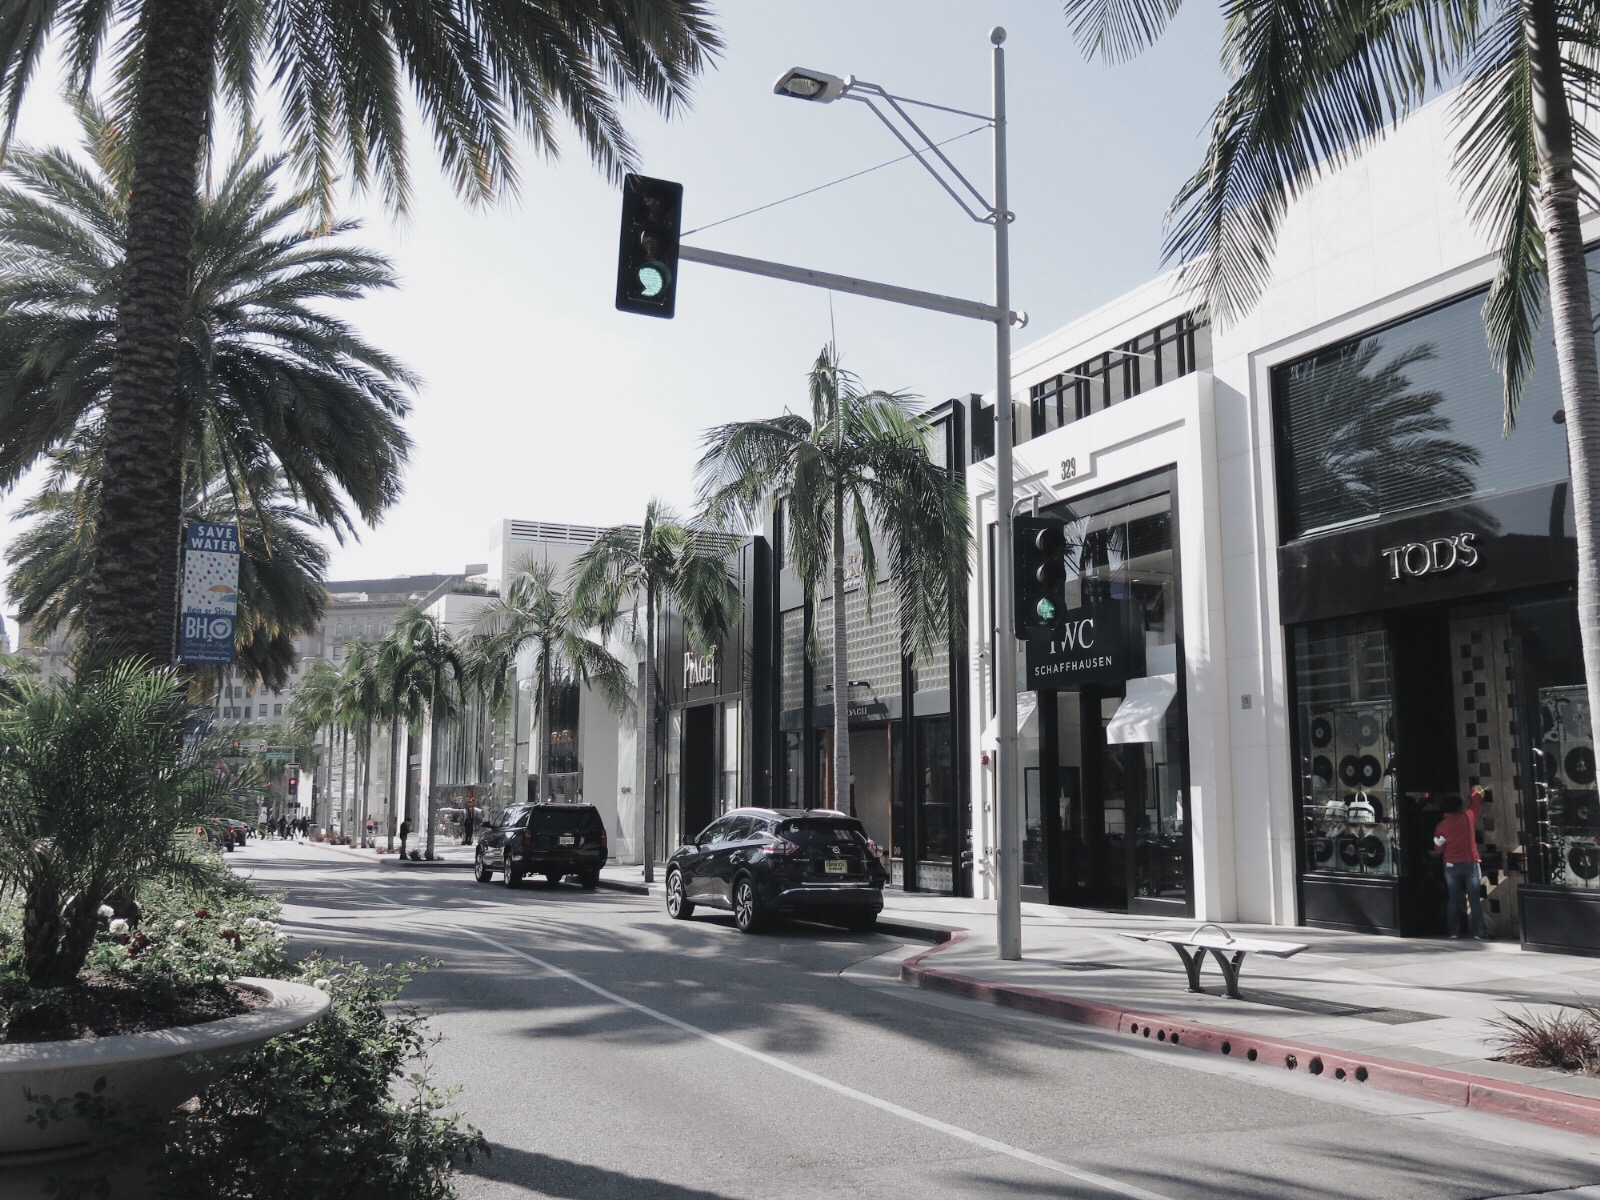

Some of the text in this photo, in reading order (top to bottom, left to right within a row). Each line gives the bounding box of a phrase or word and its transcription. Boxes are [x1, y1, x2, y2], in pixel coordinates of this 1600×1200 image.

[1061, 457, 1076, 480] 329
[197, 525, 233, 539] SAVE
[191, 537, 237, 552] WATER
[1381, 532, 1478, 580] TOD'S
[187, 605, 202, 614] Rain
[214, 606, 233, 615] Shine
[683, 645, 717, 688] PIAGET
[1034, 655, 1112, 676] SCHAFFHAUSEN
